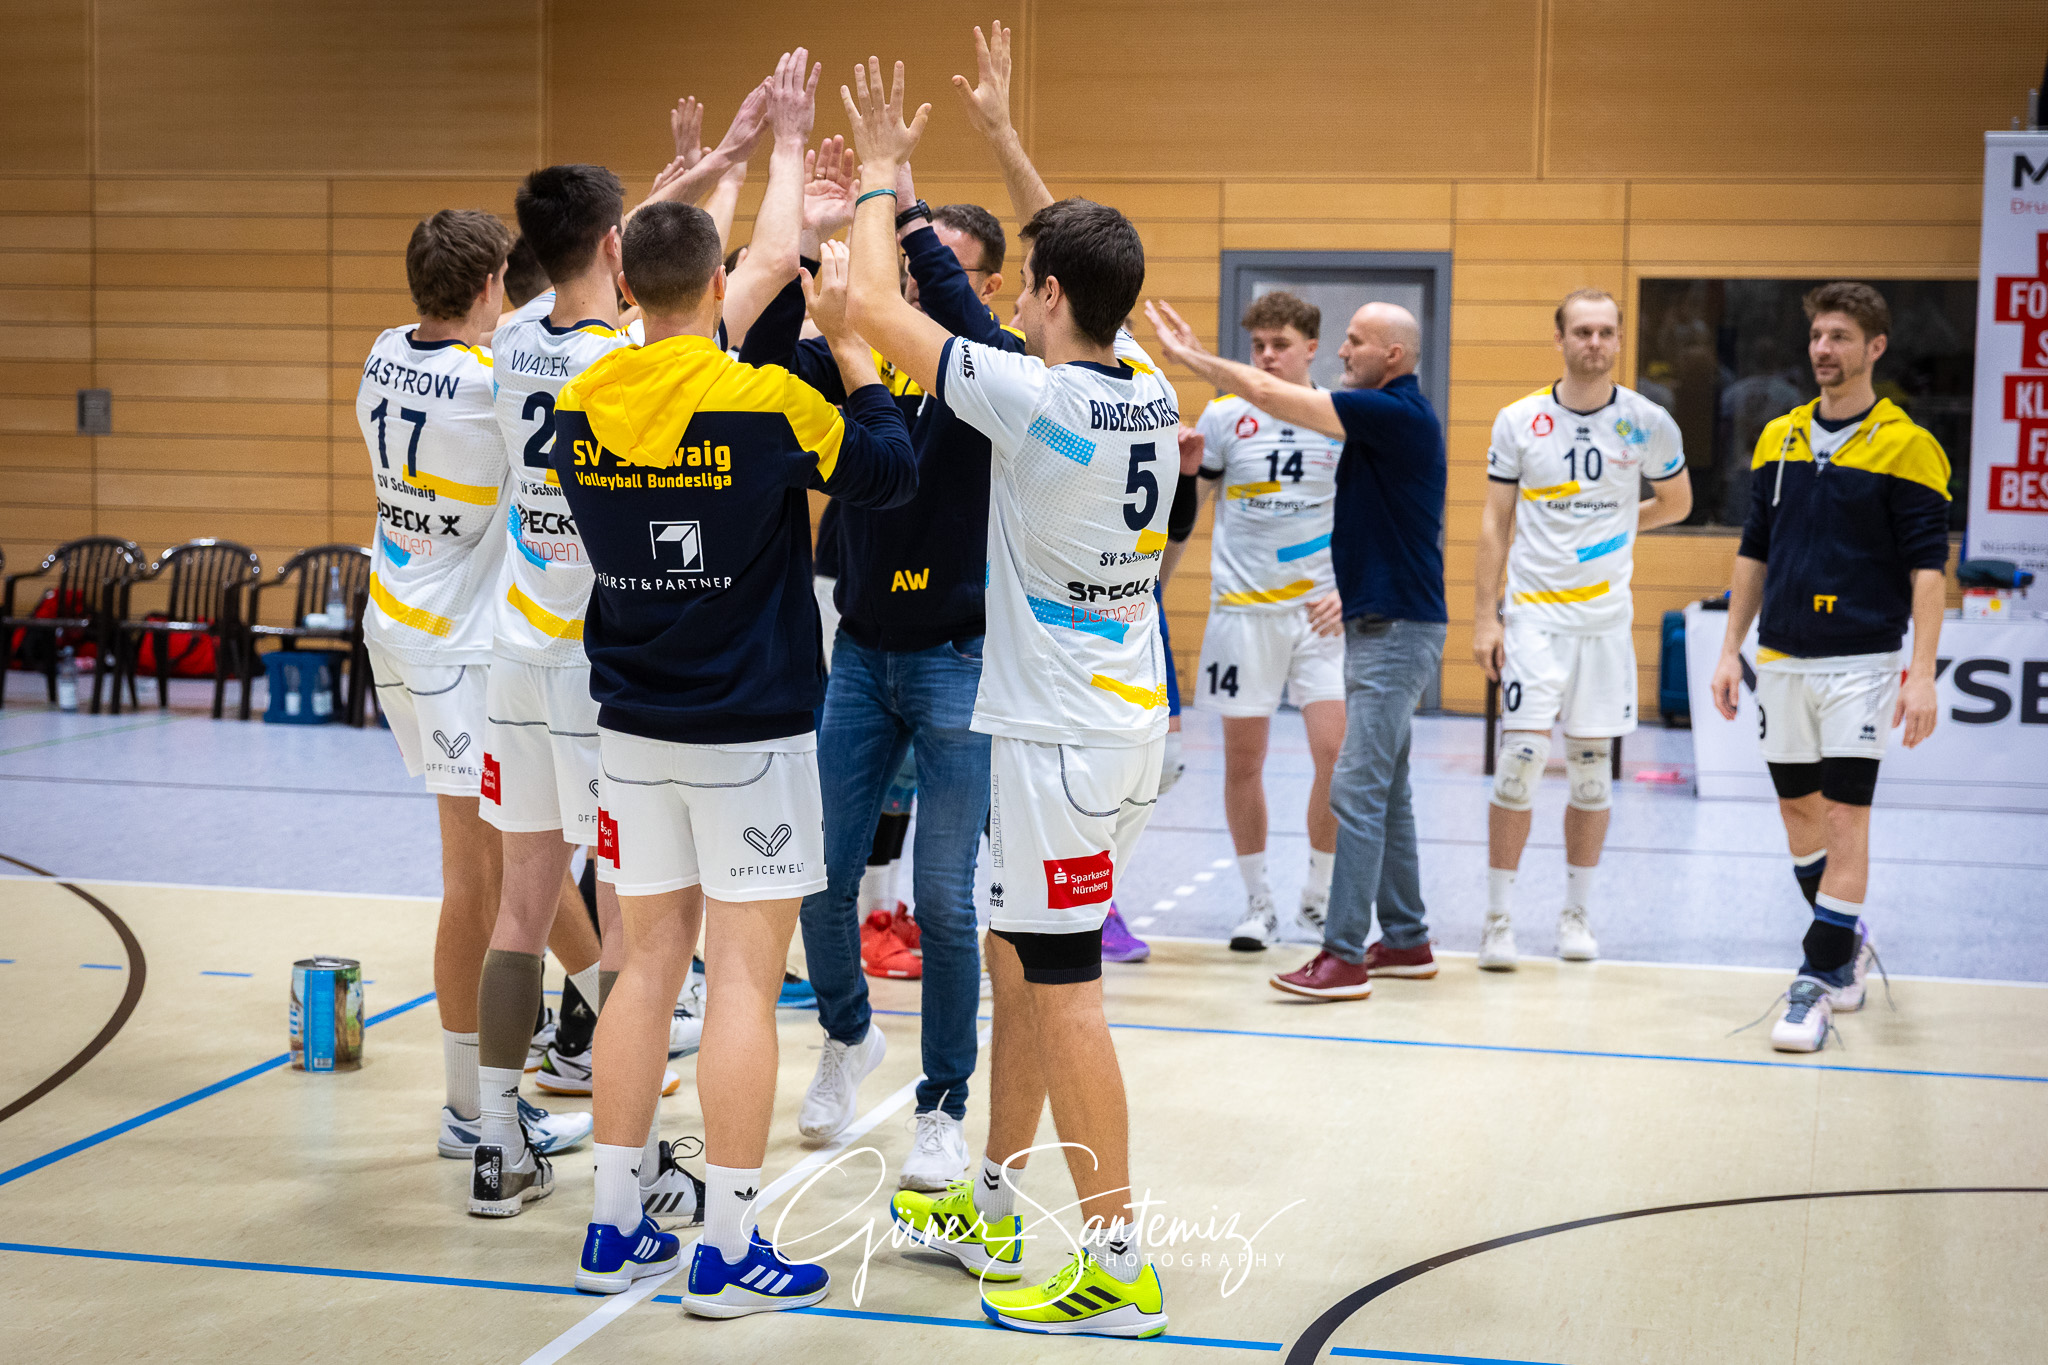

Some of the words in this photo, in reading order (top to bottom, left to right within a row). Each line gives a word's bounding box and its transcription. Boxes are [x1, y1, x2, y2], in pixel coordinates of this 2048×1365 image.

[512, 349, 570, 377] WACEK
[371, 398, 427, 477] 17
[573, 440, 603, 467] SV
[1564, 447, 1602, 481] 10
[1266, 450, 1305, 483] 14
[377, 474, 388, 488] SV
[391, 477, 436, 501] Schwaig
[575, 471, 642, 491] Volleyball
[648, 472, 732, 490] Bundesliga
[1123, 441, 1159, 531] 5
[1100, 552, 1117, 567] SV
[598, 572, 637, 590] FÜRST
[641, 578, 651, 590] &
[656, 577, 732, 591] PARTNER
[891, 568, 929, 592] AW
[1067, 577, 1150, 603] SPECK
[1813, 594, 1838, 614] FT
[1206, 661, 1239, 698] 14
[426, 763, 483, 776] OFFICEWELT
[730, 862, 805, 877] OFFICEWELT
[1070, 868, 1110, 884] Sparkasse
[1072, 881, 1108, 894] Nürnberg
